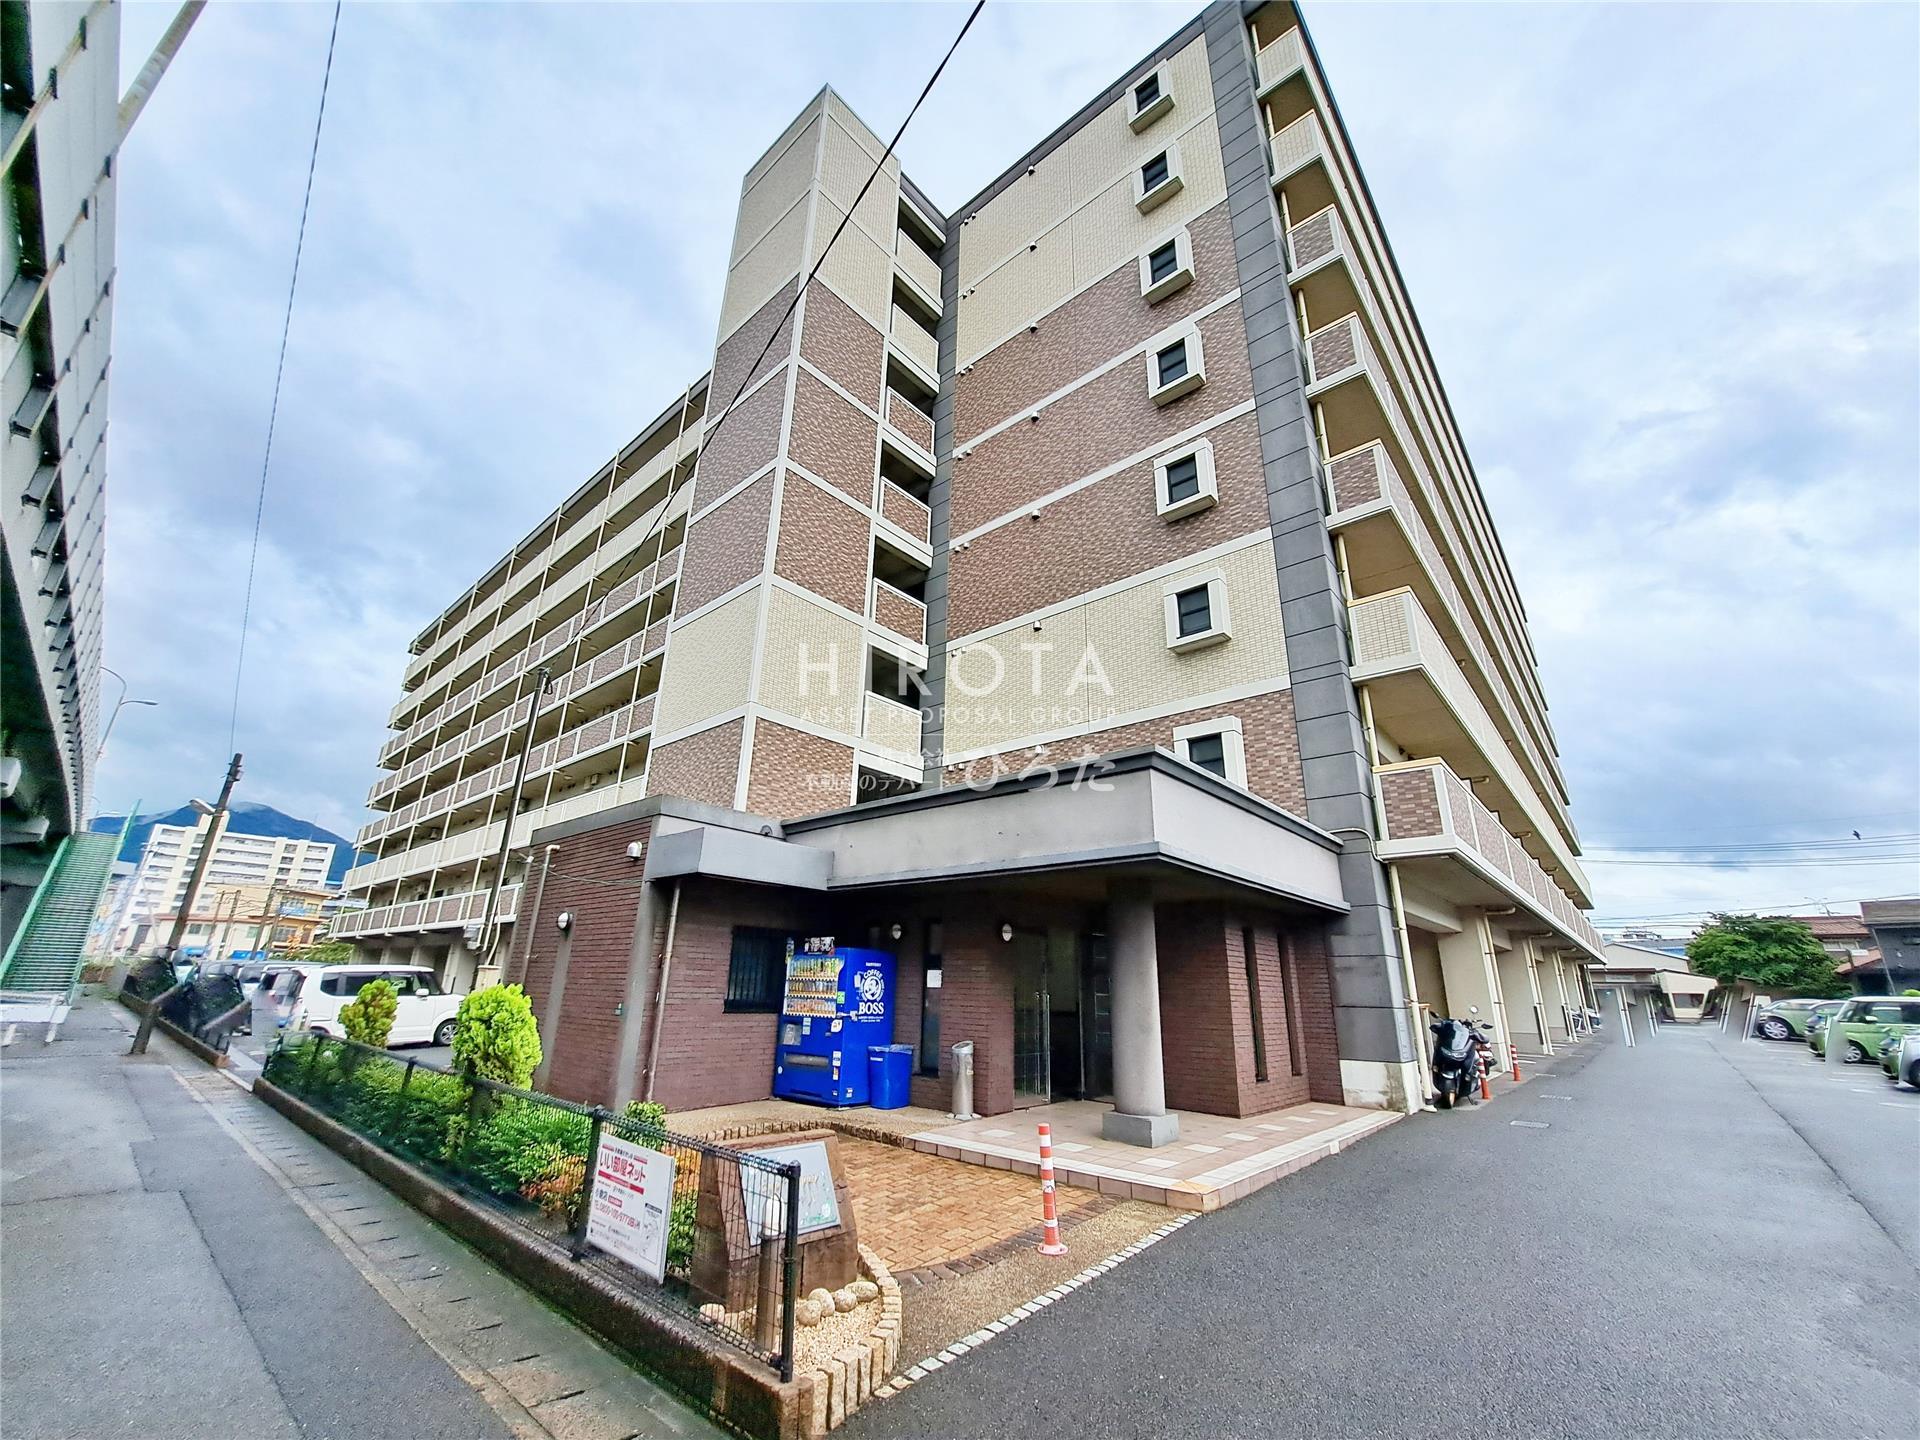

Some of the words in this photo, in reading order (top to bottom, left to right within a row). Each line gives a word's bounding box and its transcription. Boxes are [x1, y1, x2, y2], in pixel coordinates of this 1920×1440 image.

[863, 969, 883, 979] COFFEE
[858, 1001, 885, 1015] BOSS
[599, 1151, 646, 1183] いい部屋ネット
